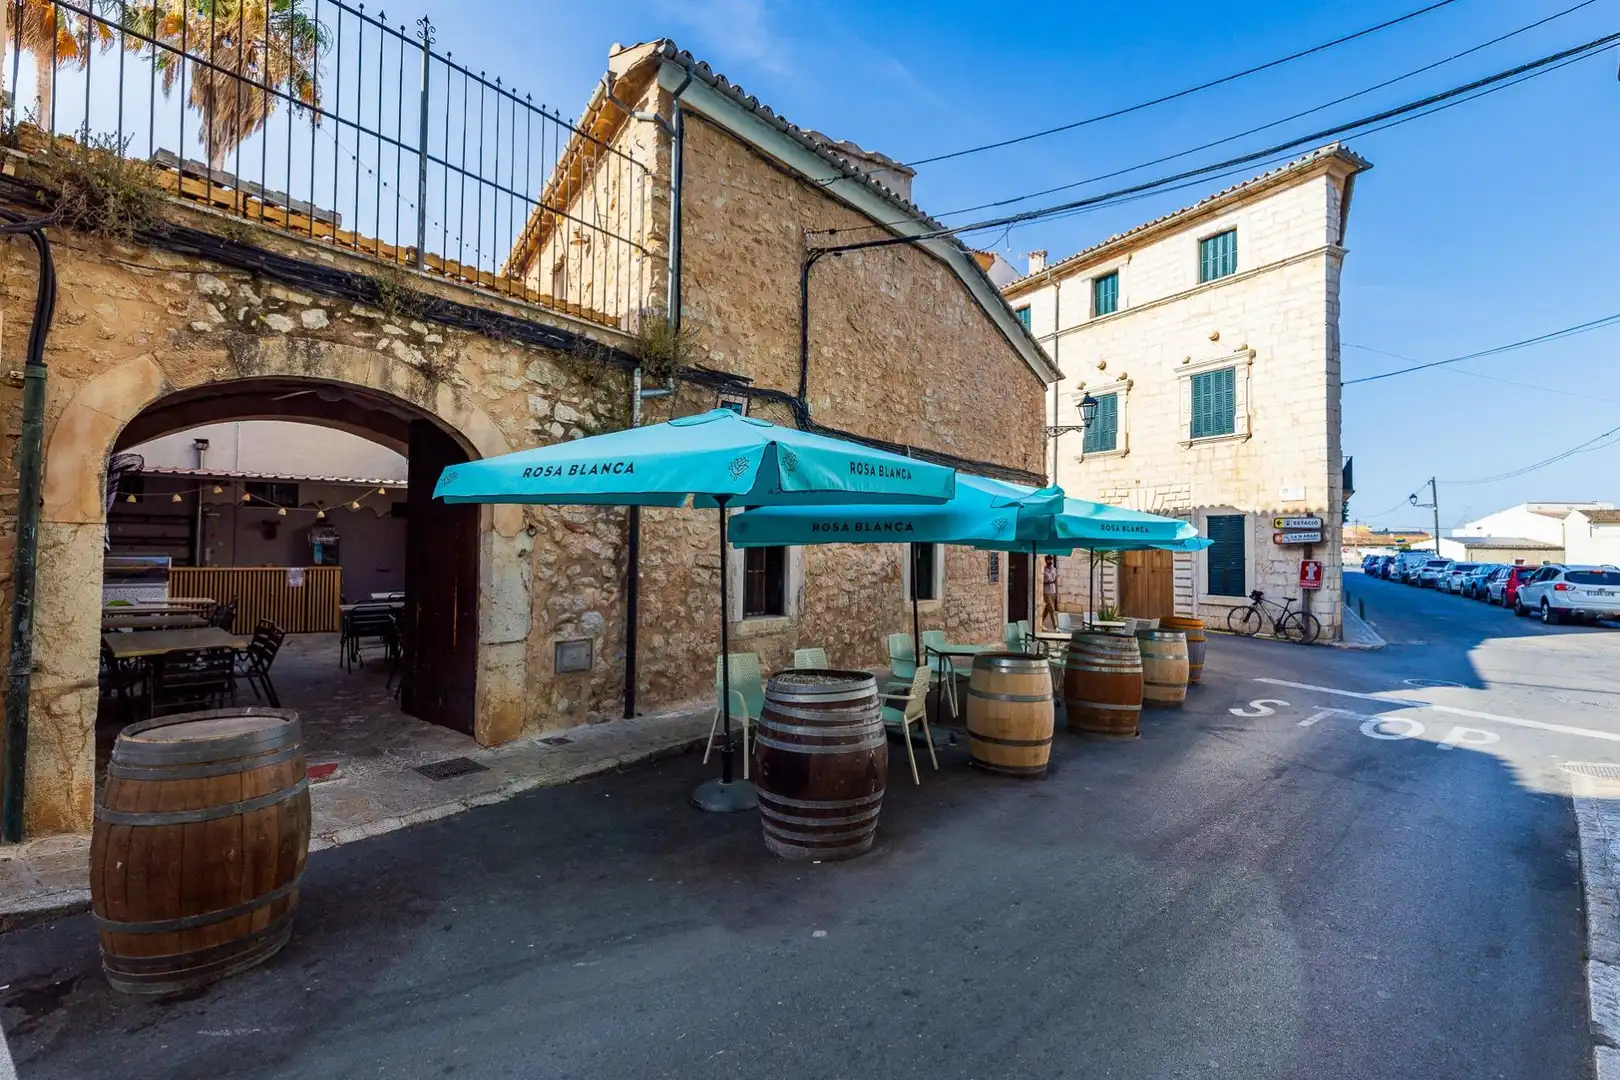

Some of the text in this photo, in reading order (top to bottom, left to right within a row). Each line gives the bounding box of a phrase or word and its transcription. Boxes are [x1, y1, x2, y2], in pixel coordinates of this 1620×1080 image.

[522, 461, 635, 478] ROSA BLANCA
[850, 461, 912, 480] ROSA BLANCA
[812, 521, 914, 532] ROSA BLANCA
[1100, 524, 1149, 533] ROSA BLANCA
[1228, 699, 1501, 750] STOP
